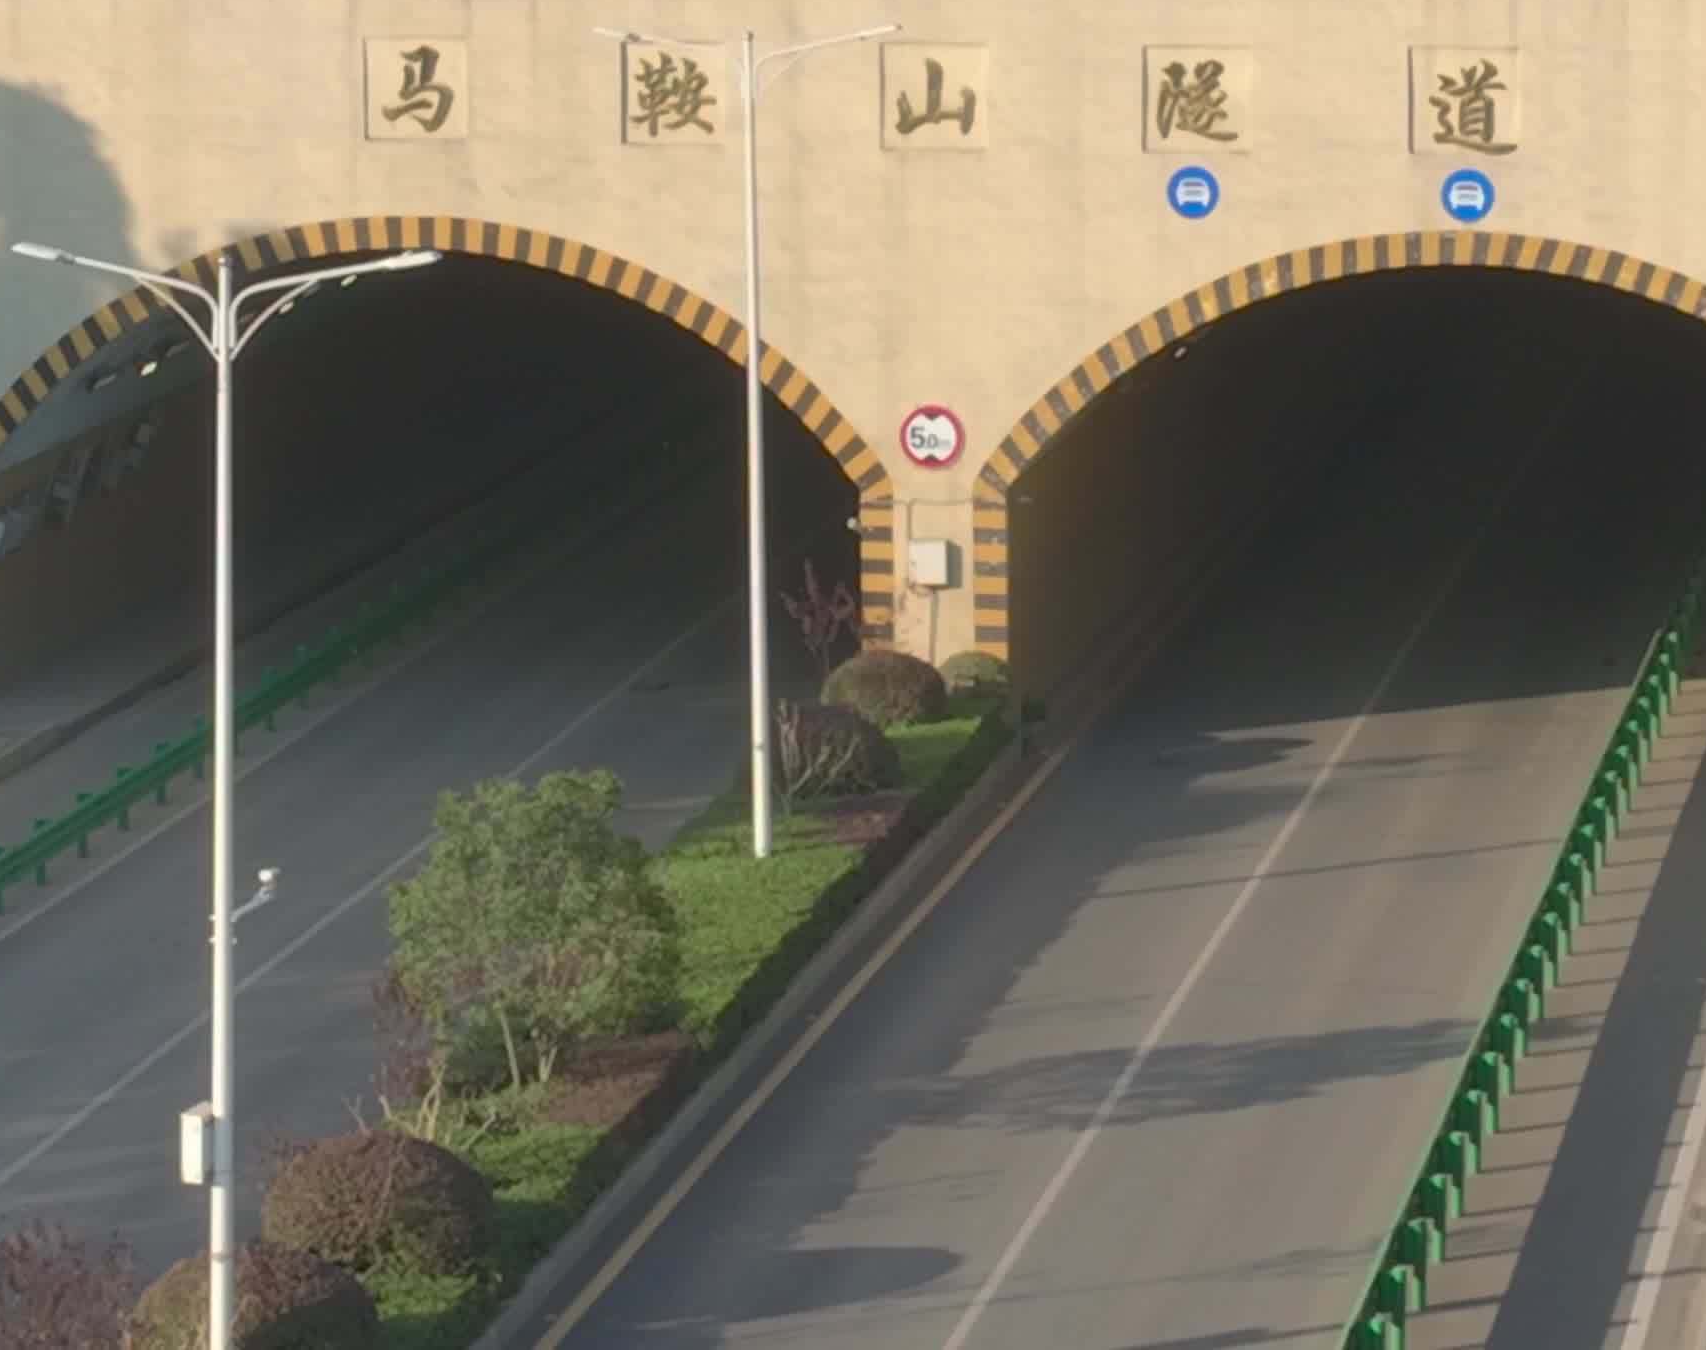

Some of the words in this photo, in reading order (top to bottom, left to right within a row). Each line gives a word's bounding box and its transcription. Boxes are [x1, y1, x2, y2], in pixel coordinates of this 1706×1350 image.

[381, 46, 1517, 155] 马鞍山隧道
